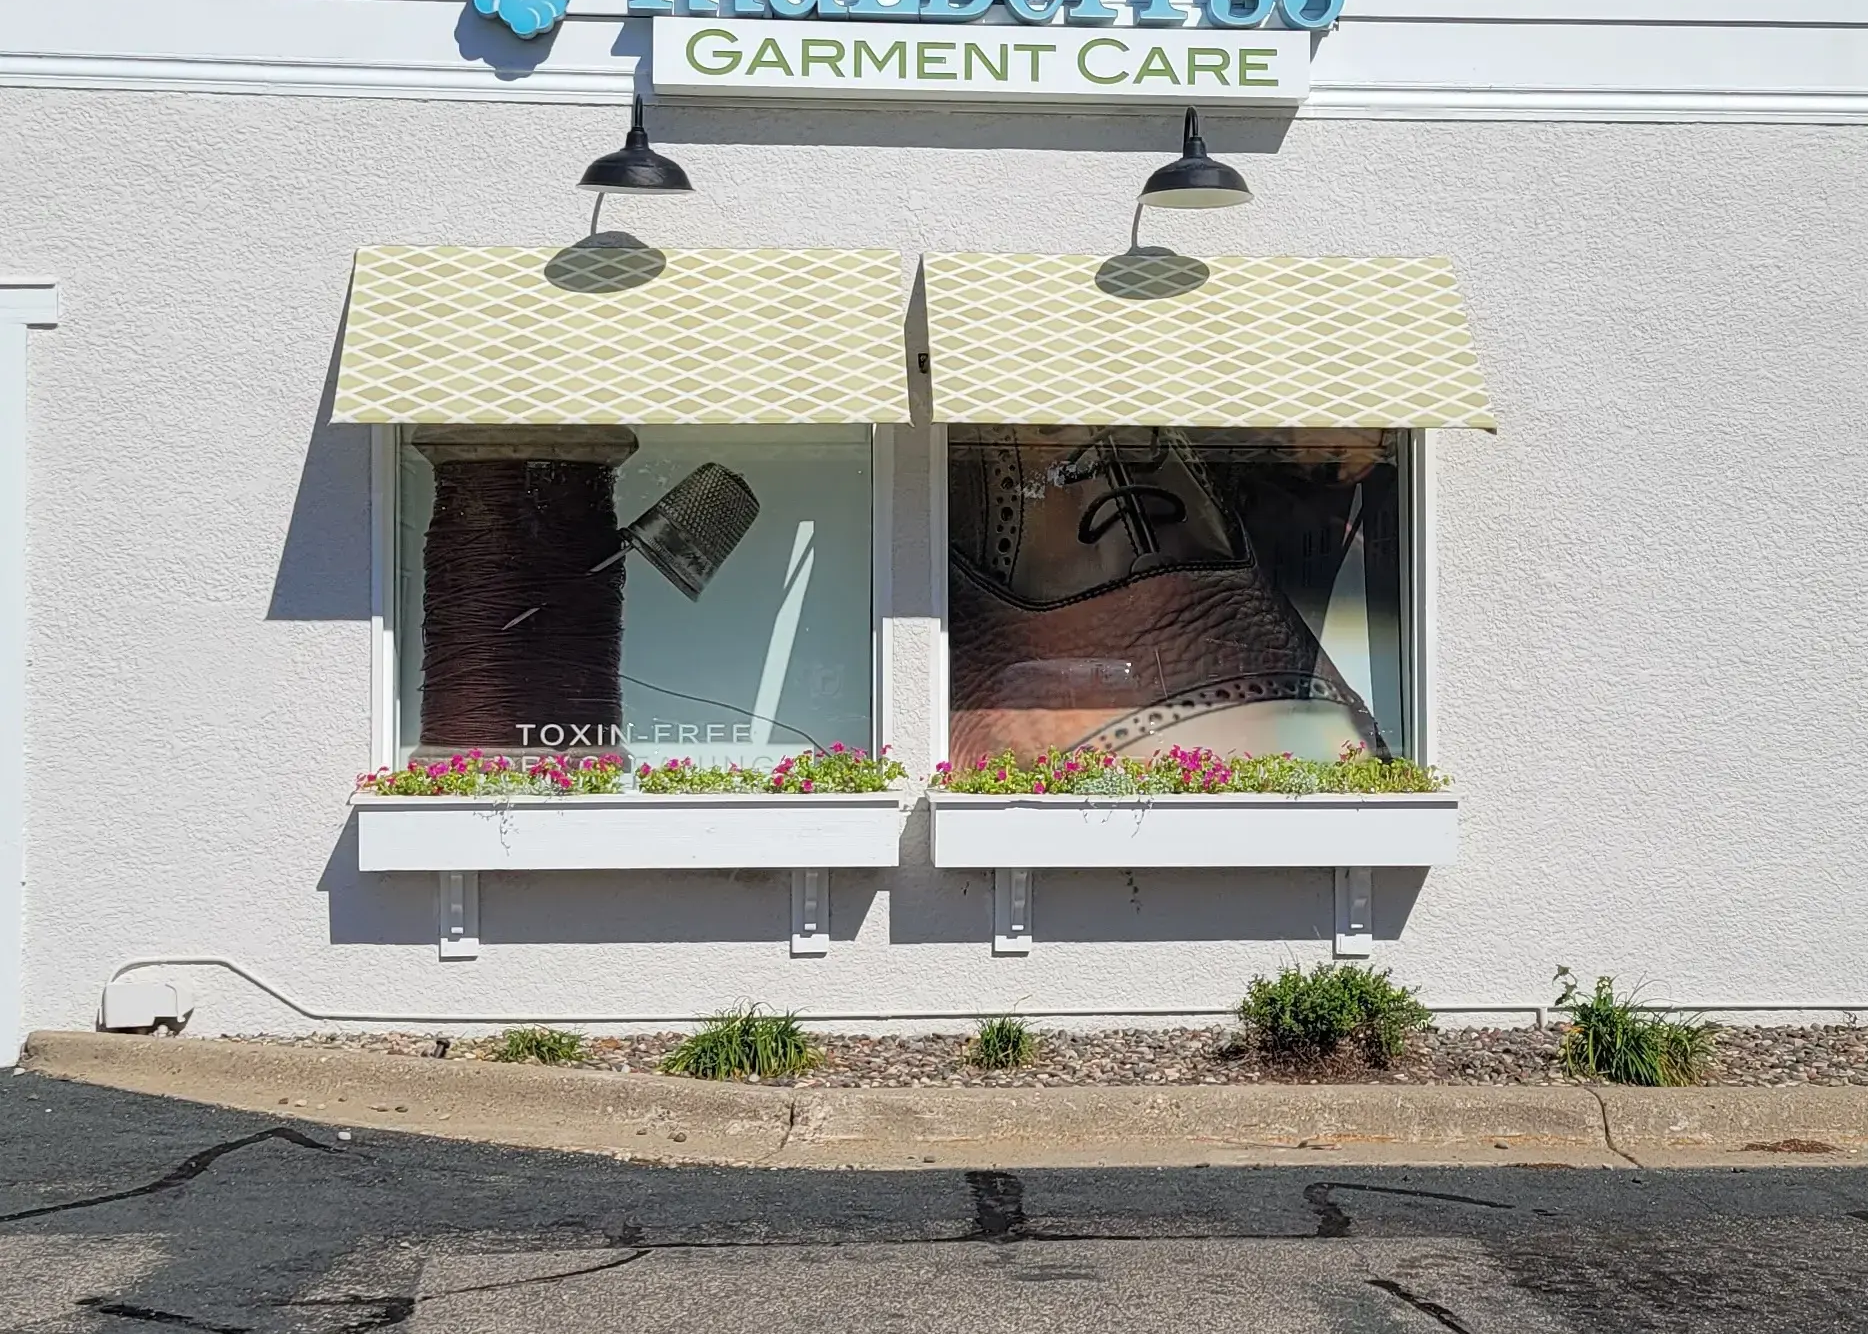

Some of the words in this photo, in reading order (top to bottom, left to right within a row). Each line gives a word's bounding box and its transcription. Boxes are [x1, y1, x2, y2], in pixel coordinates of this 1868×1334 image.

[685, 28, 1057, 83] GARMENT
[1077, 38, 1279, 87] CARE
[515, 723, 751, 746] TOXIN-FREE
